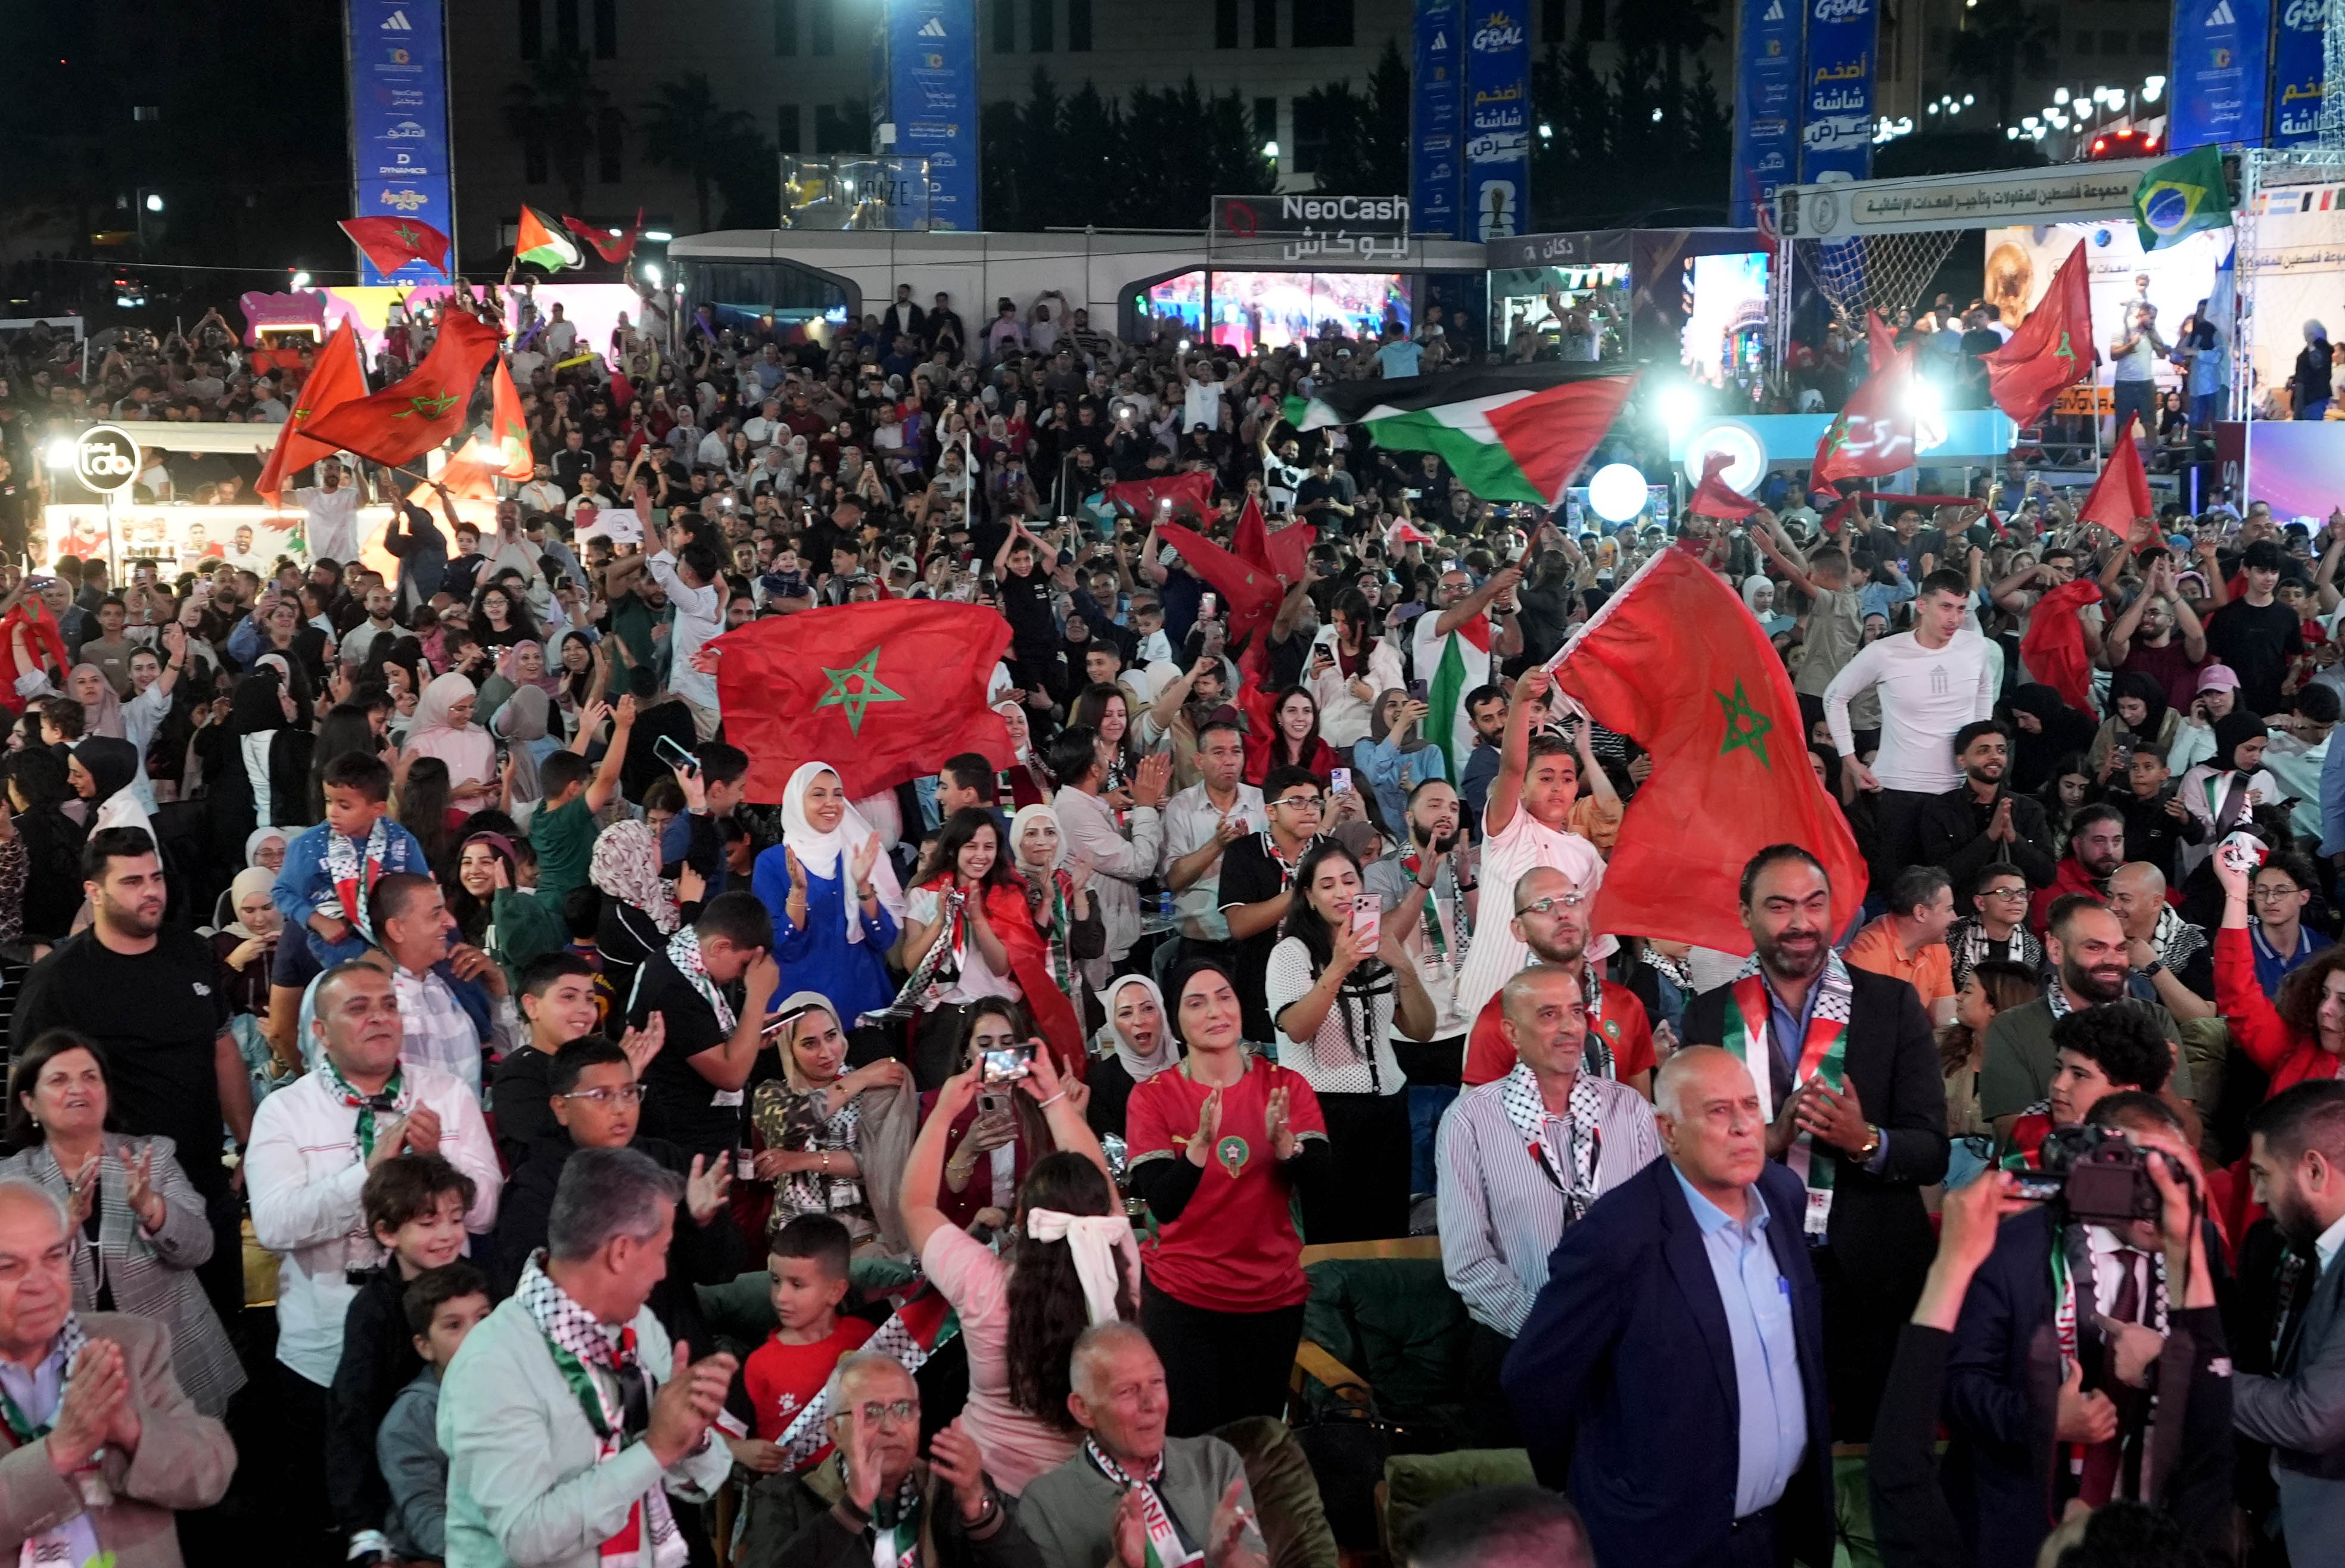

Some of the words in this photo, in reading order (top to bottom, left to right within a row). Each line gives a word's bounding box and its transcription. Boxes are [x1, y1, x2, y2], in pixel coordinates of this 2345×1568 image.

[1472, 27, 1523, 50] GOAL
[1813, 87, 1864, 110] شاشة
[1475, 107, 1522, 128] شاشة
[2281, 108, 2320, 135] اشة
[2038, 182, 2081, 206] فلسطين
[2083, 184, 2128, 201] مجموعة
[1282, 195, 1410, 220] NeoCash
[1542, 238, 1574, 259] دكان
